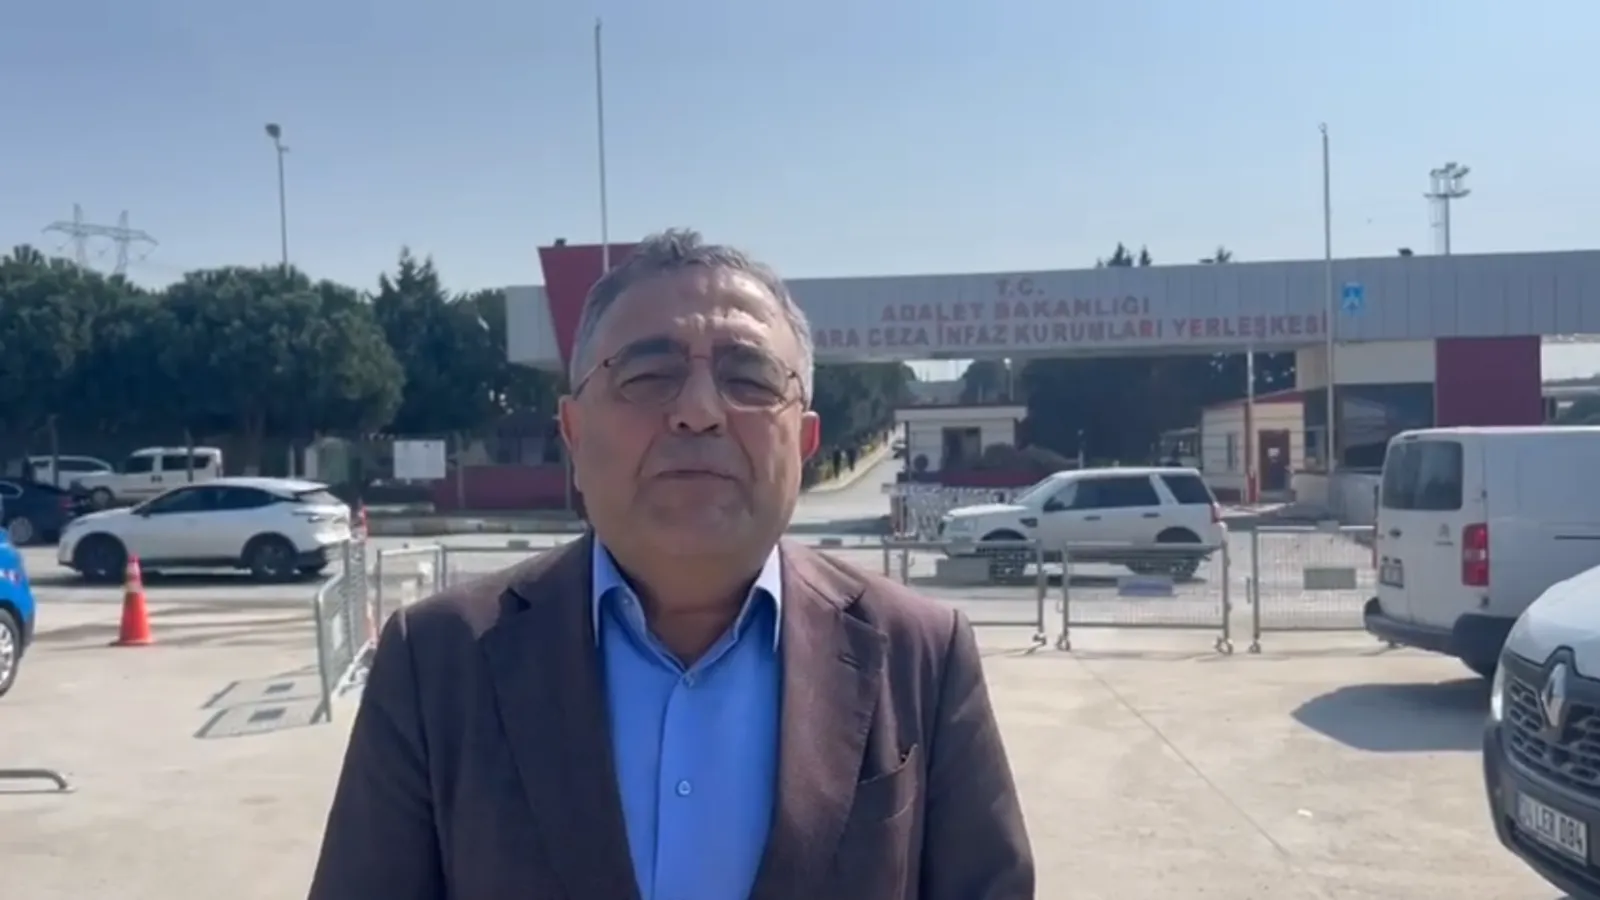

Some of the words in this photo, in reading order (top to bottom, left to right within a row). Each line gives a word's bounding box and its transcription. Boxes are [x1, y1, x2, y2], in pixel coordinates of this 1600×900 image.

[995, 277, 1045, 297] T.C.
[881, 302, 985, 321] ADALET
[994, 293, 1150, 319] BAKANLIĞI
[813, 328, 860, 348] ARA
[867, 326, 930, 347] CEZA
[936, 319, 1008, 346] İNFAZ
[1014, 318, 1163, 344] KURUMLARI
[1171, 309, 1328, 338] YERLEŞKESİ
